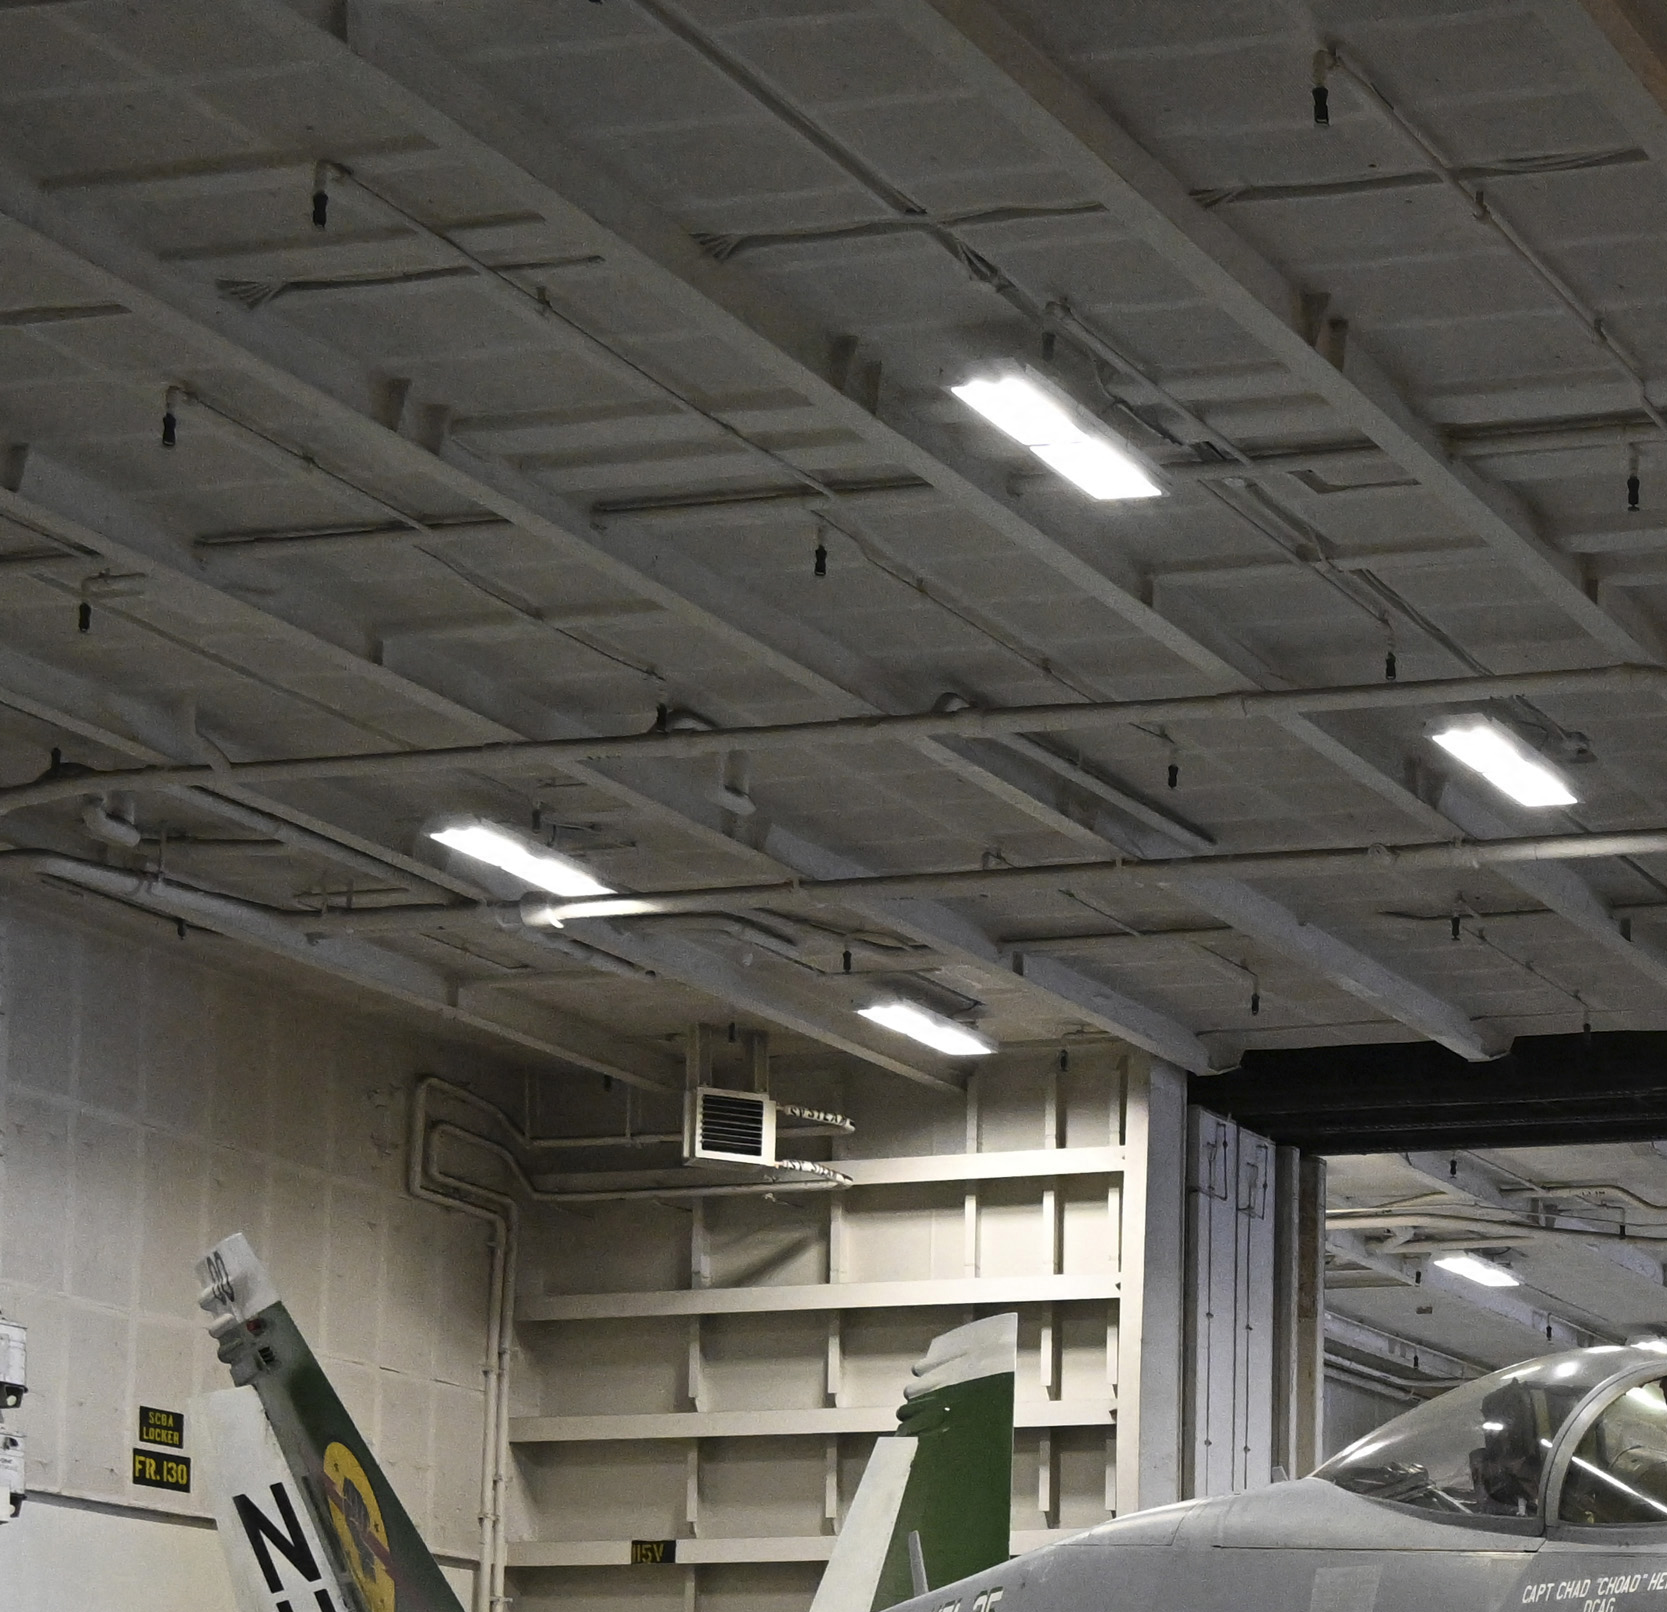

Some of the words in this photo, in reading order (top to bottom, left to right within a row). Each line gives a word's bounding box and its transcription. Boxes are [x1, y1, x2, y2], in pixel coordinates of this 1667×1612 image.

[148, 1411, 174, 1428] SCBA
[142, 1426, 180, 1445] LOCKER
[1522, 1582, 1555, 1604] CAPT
[1556, 1579, 1592, 1600] CHAD
